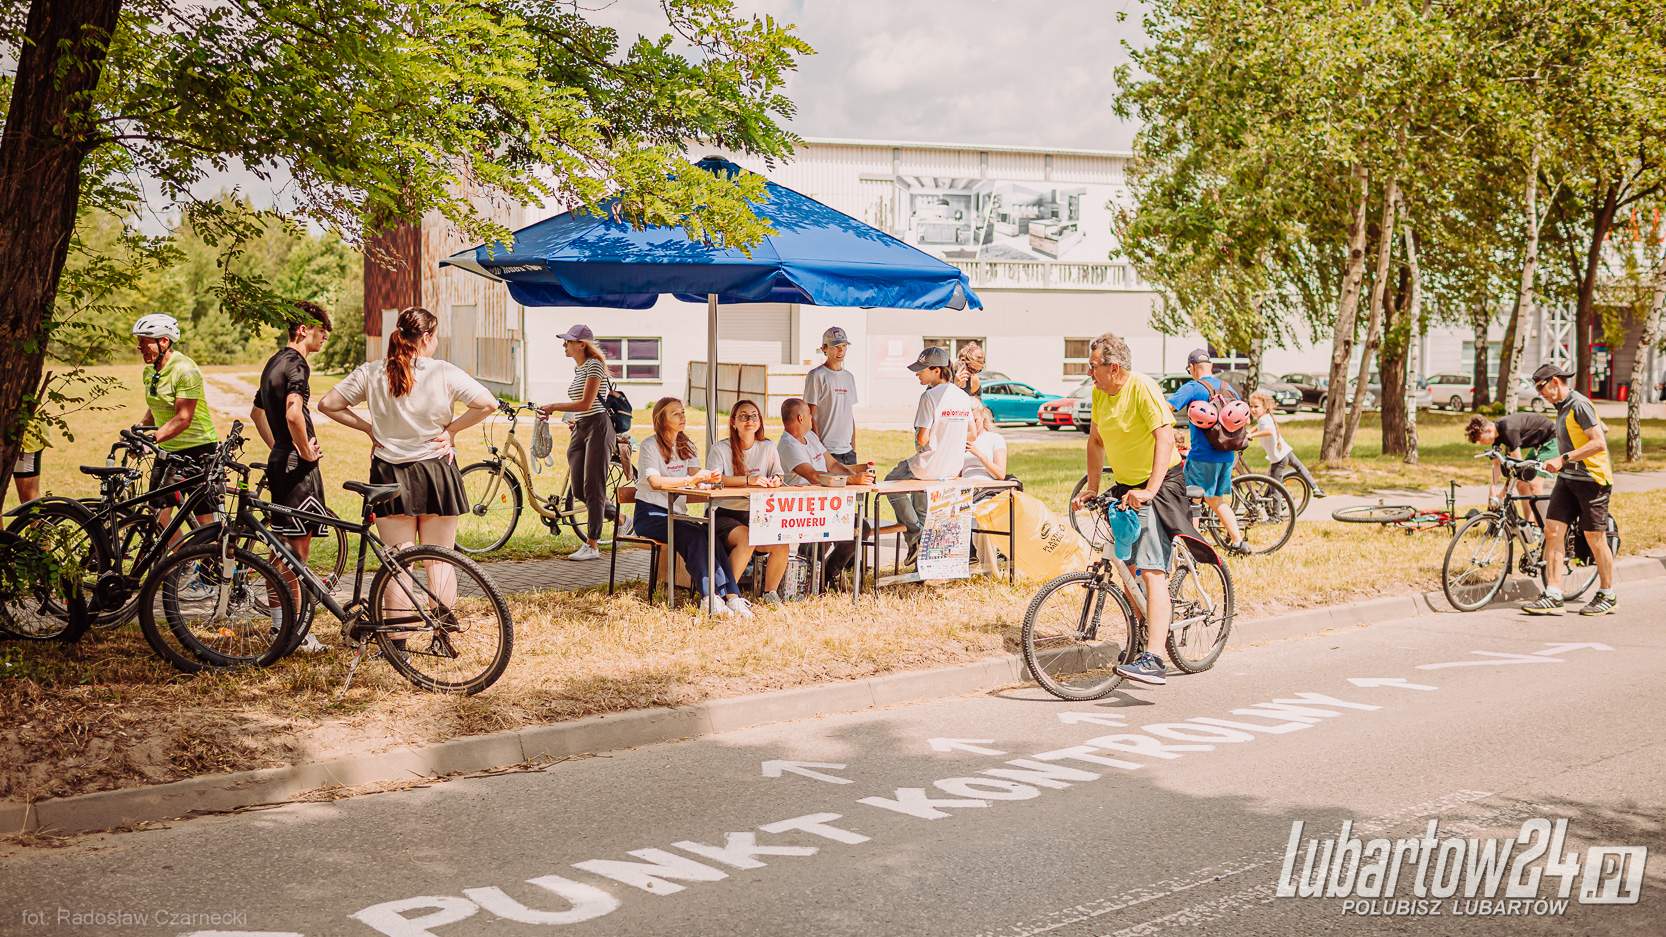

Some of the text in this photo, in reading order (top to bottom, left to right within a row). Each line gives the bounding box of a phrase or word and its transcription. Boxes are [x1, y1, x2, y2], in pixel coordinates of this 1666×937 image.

[765, 494, 843, 516] ŚWIĘTO
[781, 517, 827, 529] ROWERU
[349, 691, 1384, 937] PUNKT KONTROLNY
